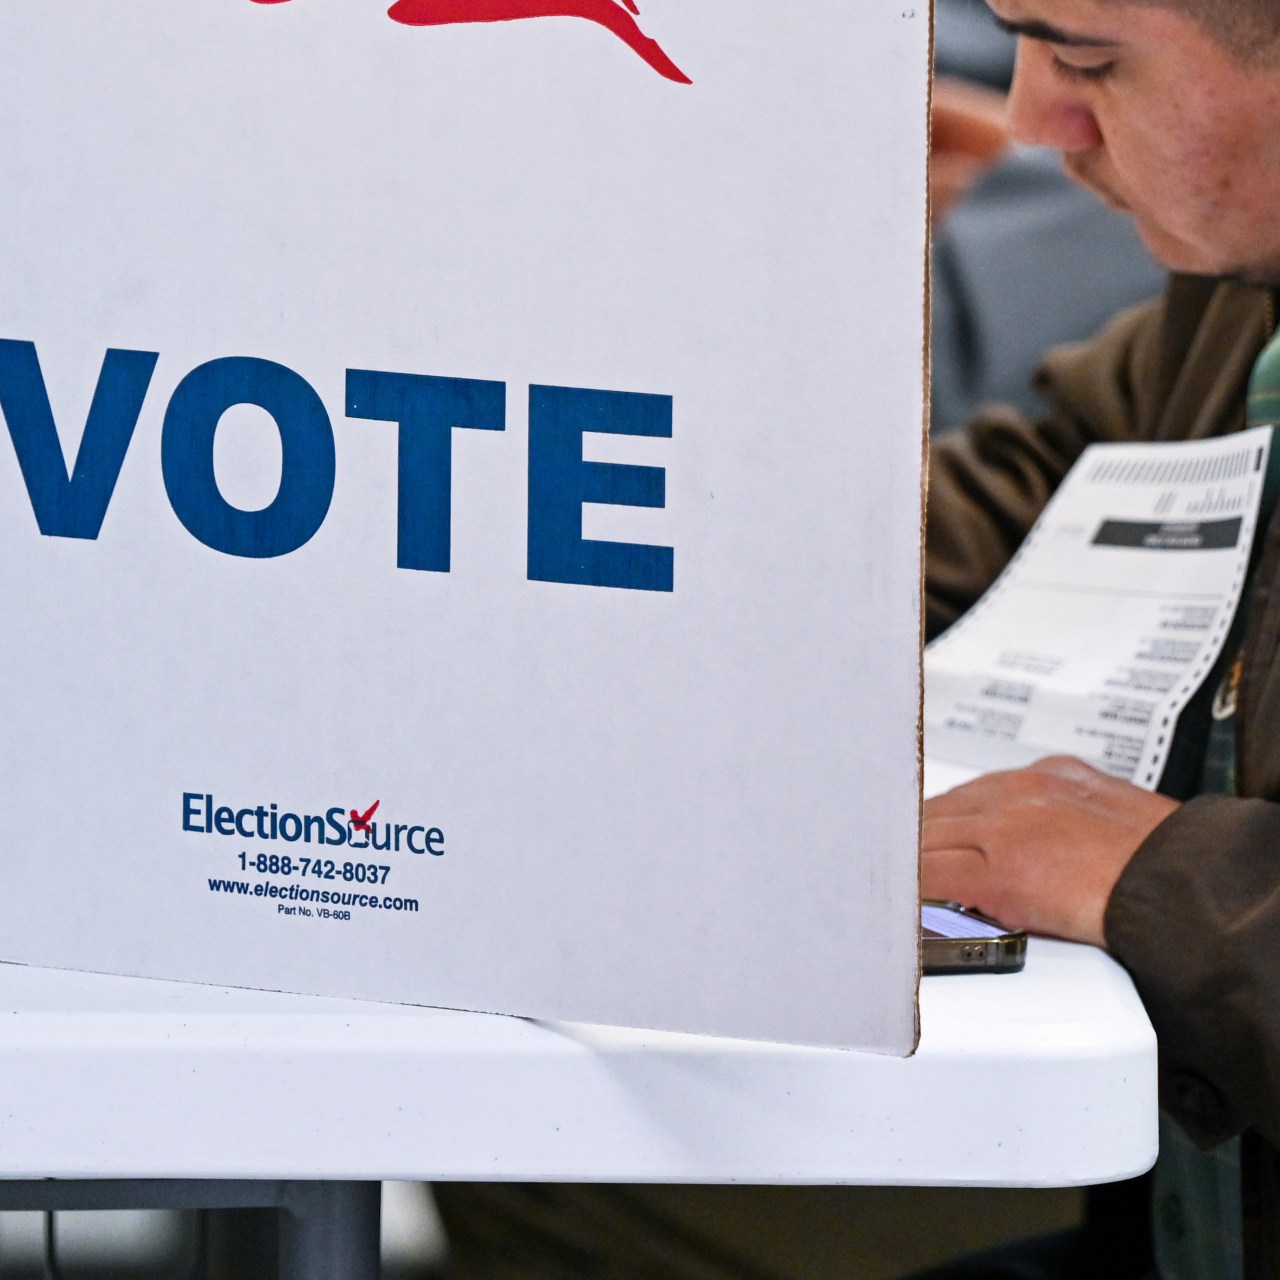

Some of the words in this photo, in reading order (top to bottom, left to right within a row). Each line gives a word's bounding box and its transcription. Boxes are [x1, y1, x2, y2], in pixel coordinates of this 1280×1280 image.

[182, 791, 445, 857] ElectionSource
[237, 851, 391, 885] 1-888-742-8037
[207, 878, 419, 912] www.electionsource.com
[277, 904, 297, 916] Part
[298, 906, 314, 917] No.
[316, 908, 351, 921] VB-60B
